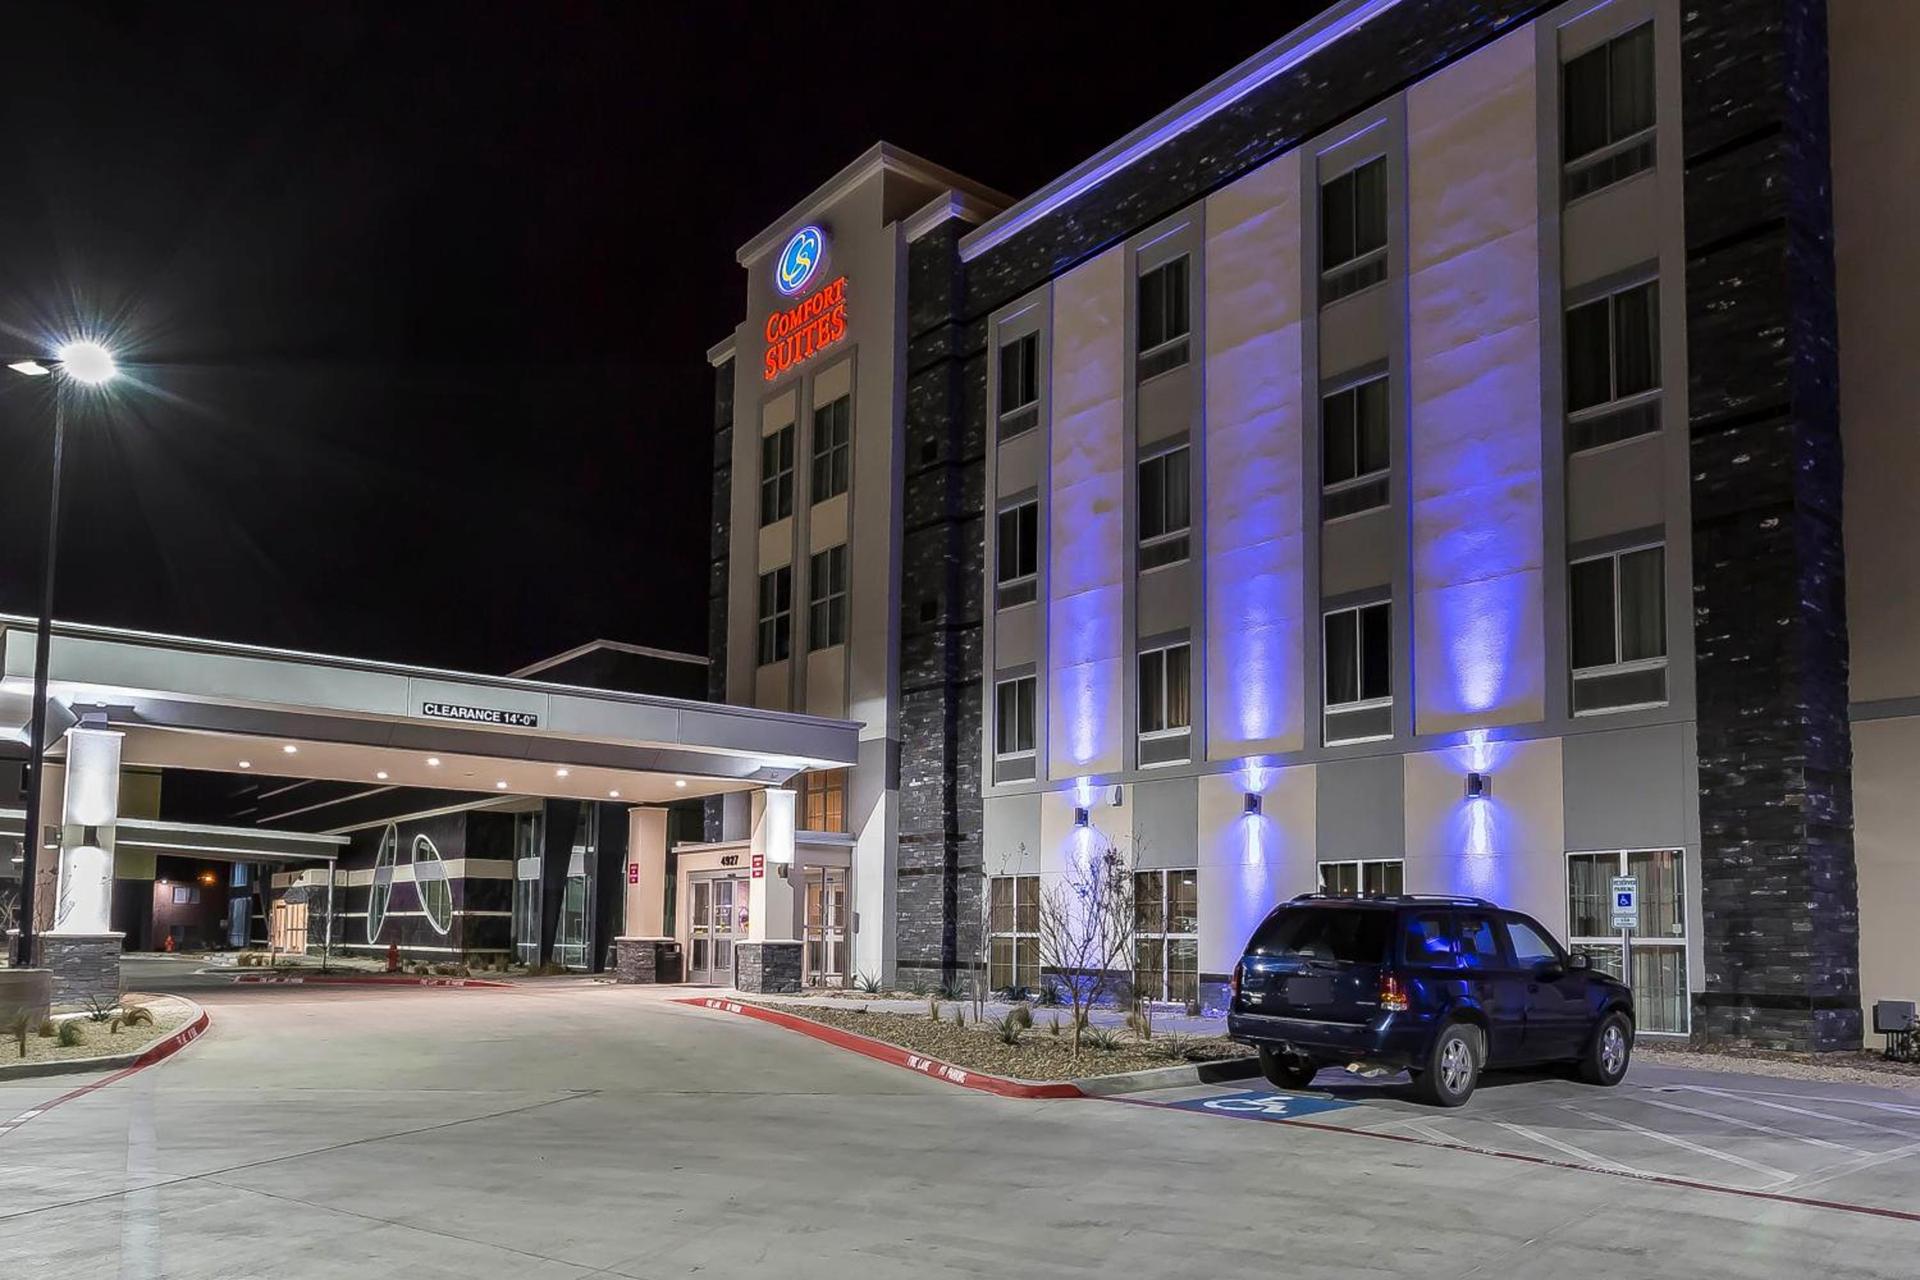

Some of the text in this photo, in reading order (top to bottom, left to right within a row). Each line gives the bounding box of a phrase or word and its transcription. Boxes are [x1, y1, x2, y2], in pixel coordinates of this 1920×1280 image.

[766, 276, 847, 343] COMFORT
[764, 304, 846, 381] SUITES
[424, 703, 501, 722] CLEARANCE
[720, 854, 739, 866] 4927
